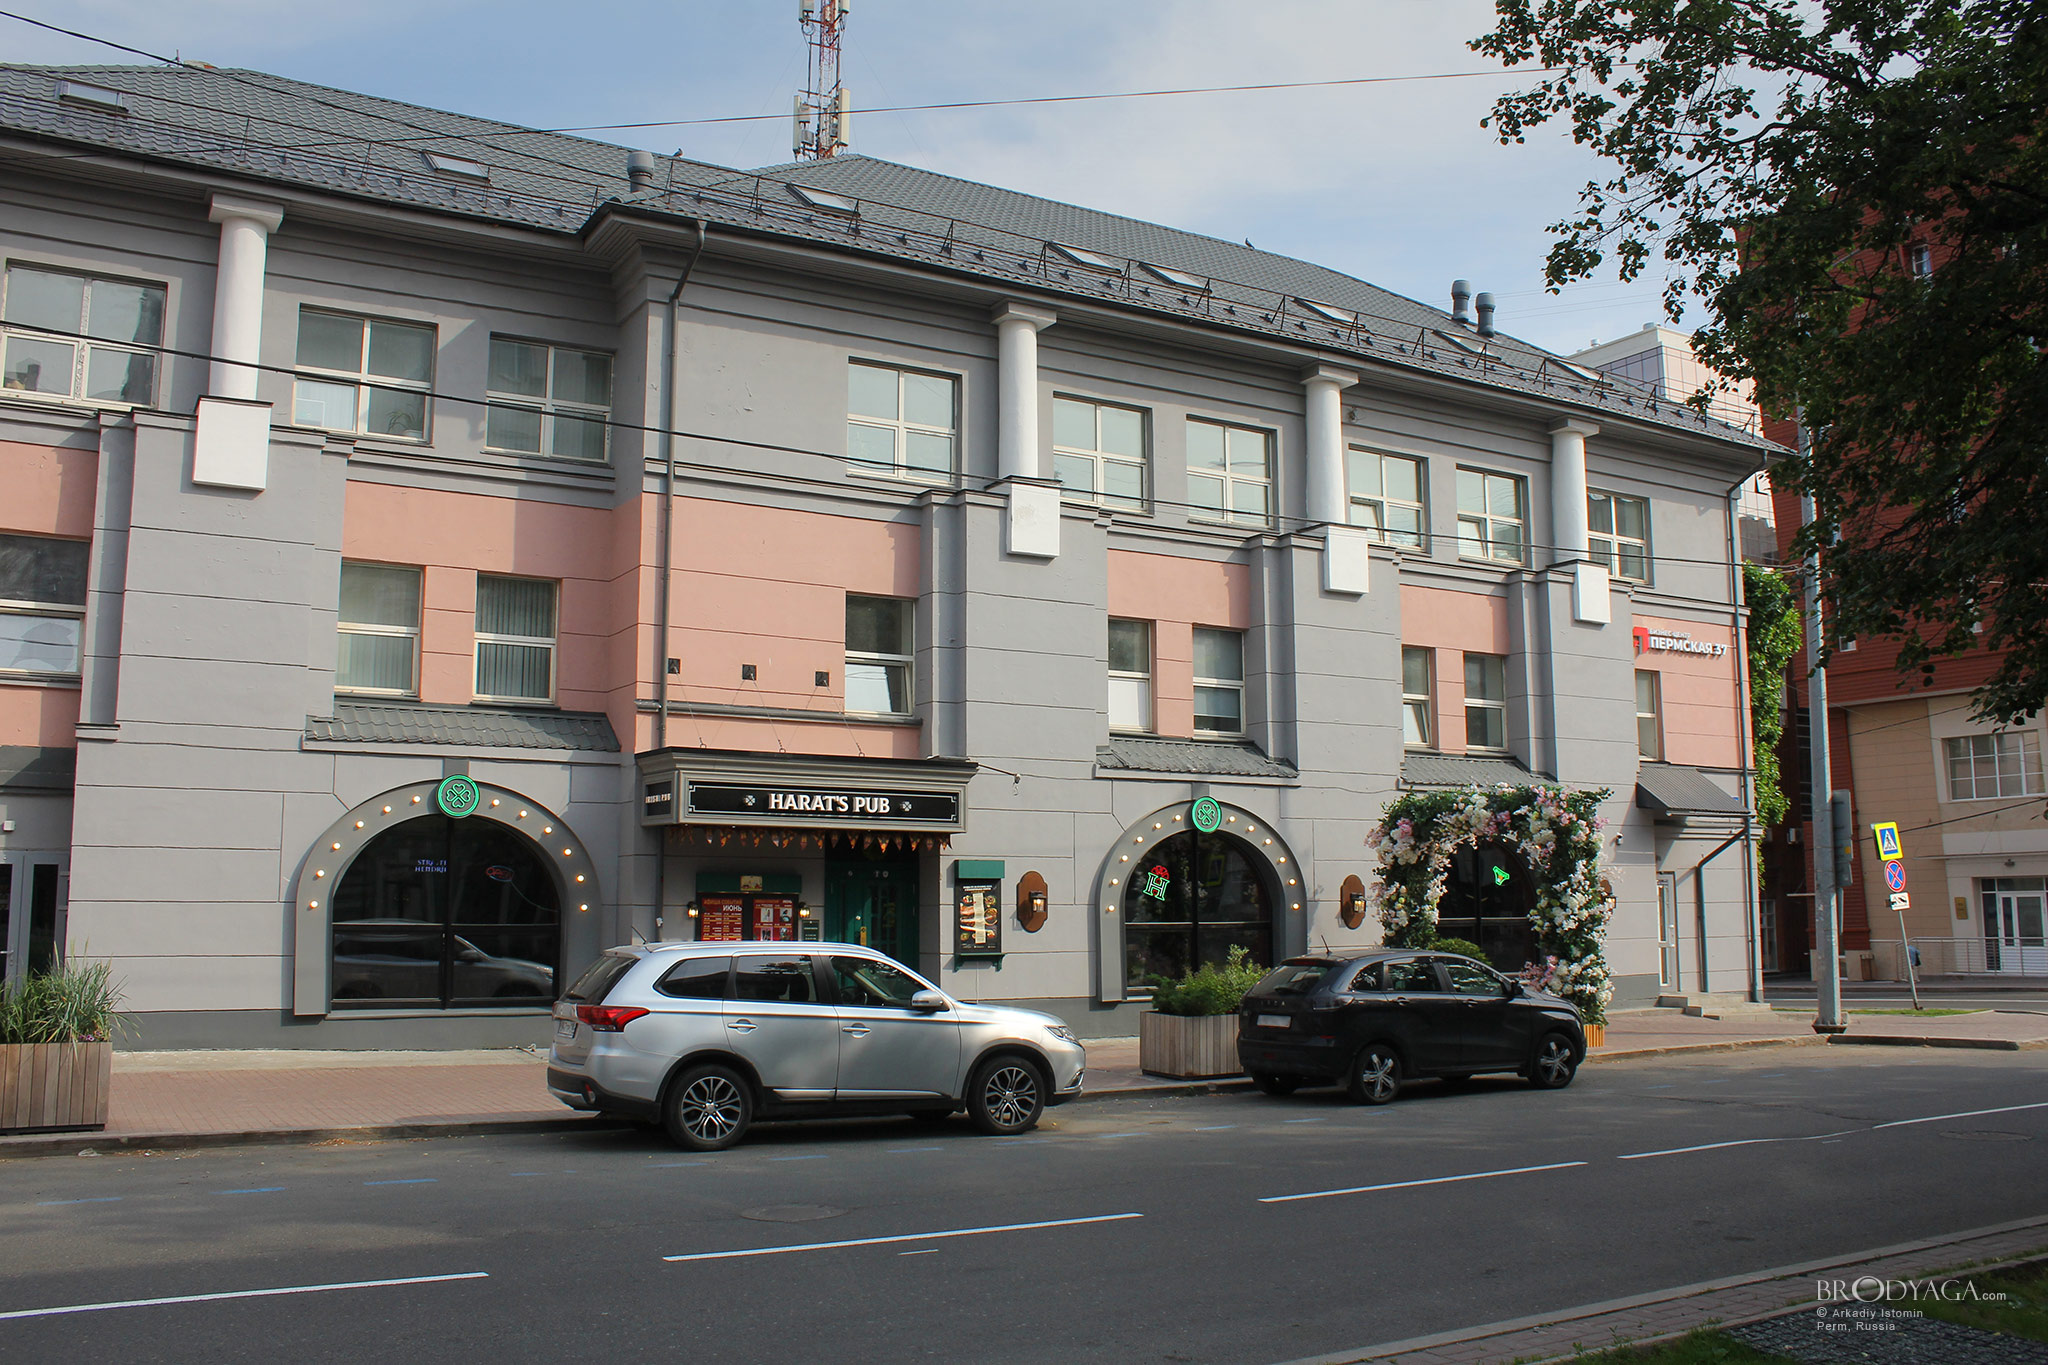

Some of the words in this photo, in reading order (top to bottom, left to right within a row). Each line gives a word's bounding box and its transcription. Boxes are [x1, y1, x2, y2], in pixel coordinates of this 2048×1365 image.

[1650, 636, 1713, 654] ПЕРМСКАЯ
[1714, 643, 1728, 655] 37
[768, 793, 849, 812] HARAT'S
[853, 796, 890, 814] PUB
[723, 904, 742, 912] ИЮНЬ
